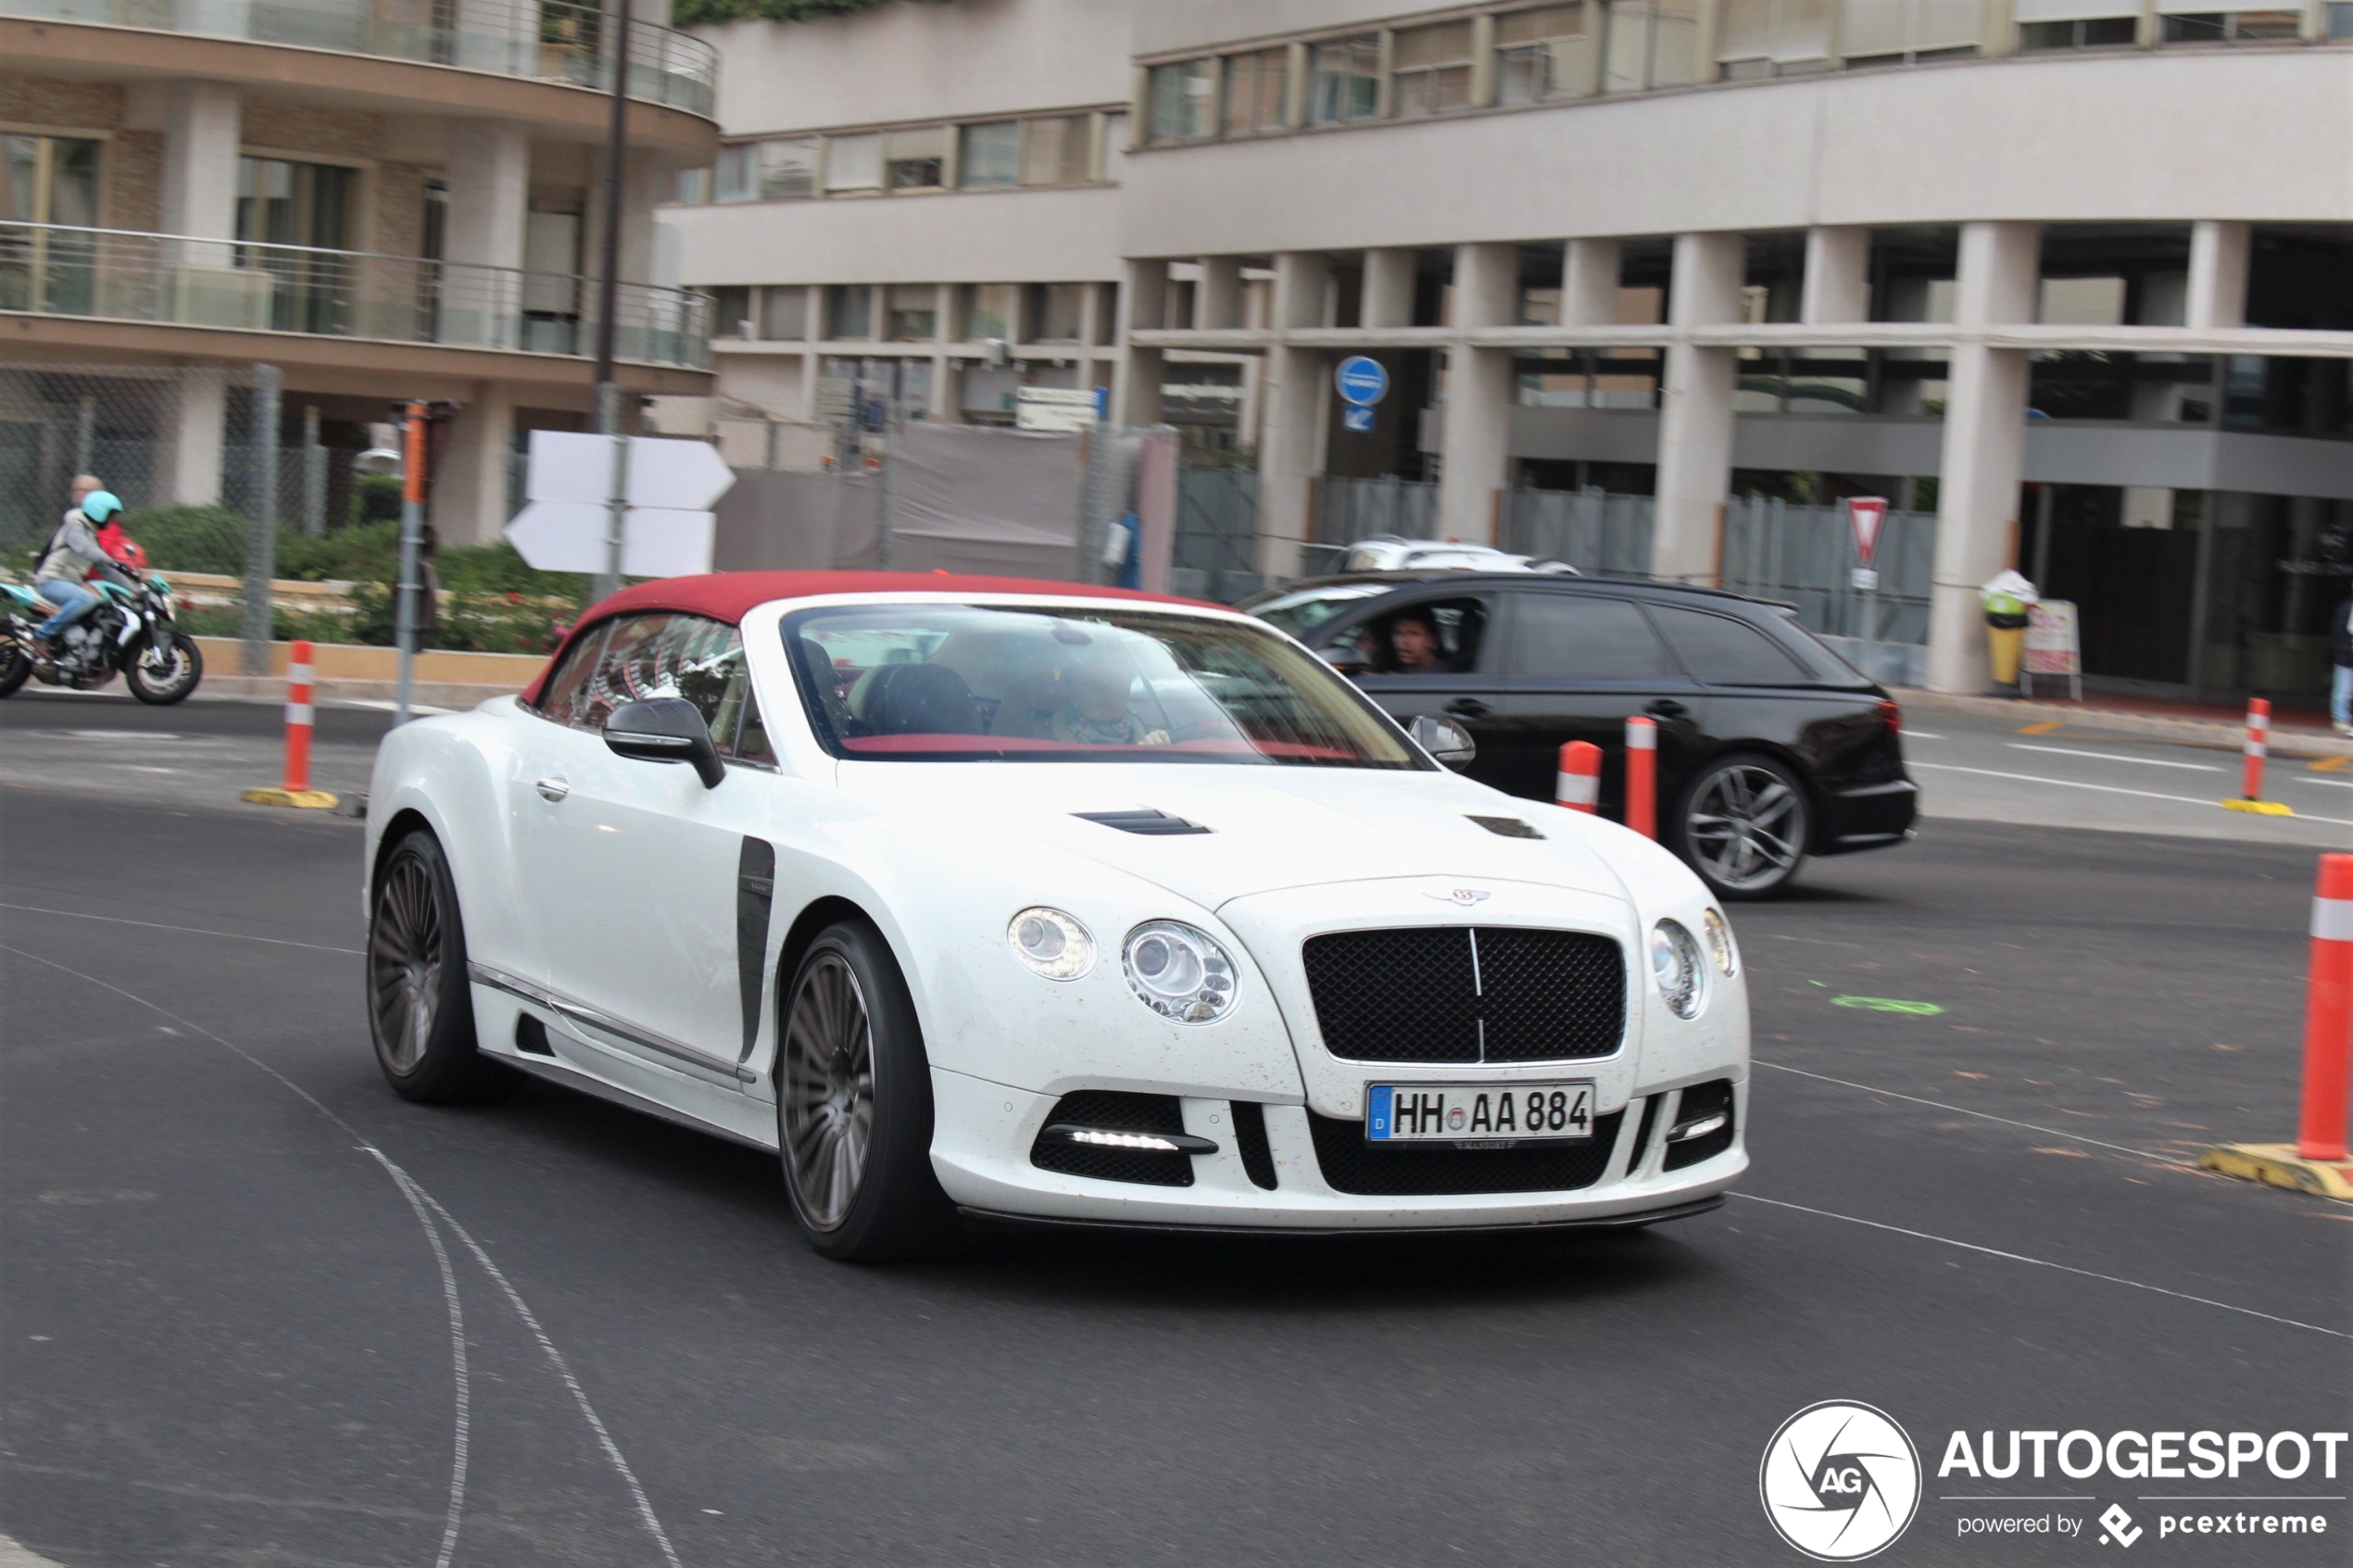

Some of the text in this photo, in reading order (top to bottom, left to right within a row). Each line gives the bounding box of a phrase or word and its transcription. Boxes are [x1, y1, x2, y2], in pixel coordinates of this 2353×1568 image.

[1375, 1118, 1385, 1130] D
[1394, 1090, 1587, 1134] HH AA 884
